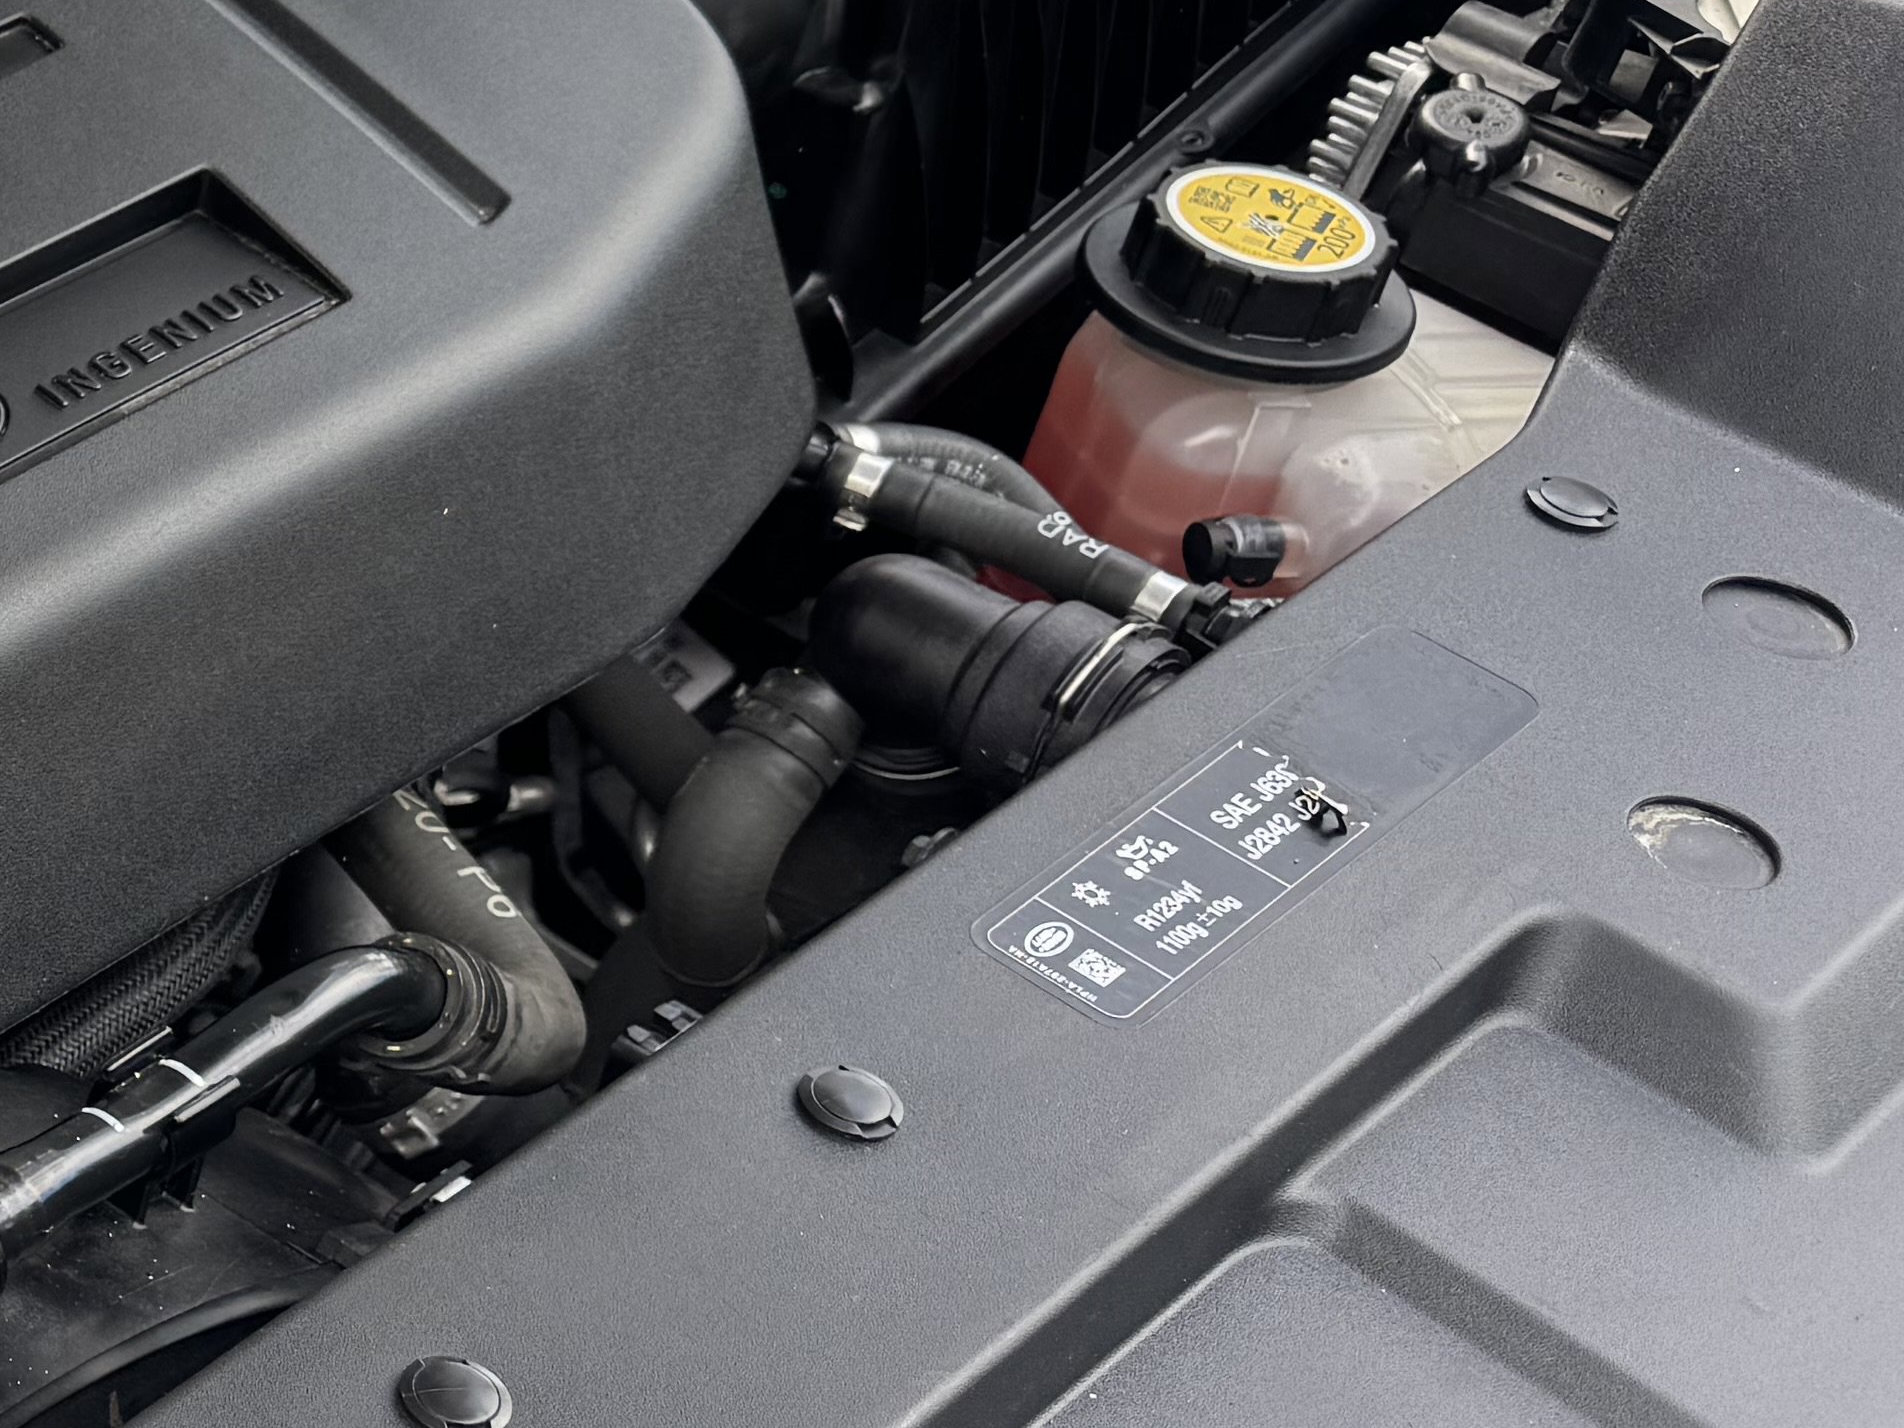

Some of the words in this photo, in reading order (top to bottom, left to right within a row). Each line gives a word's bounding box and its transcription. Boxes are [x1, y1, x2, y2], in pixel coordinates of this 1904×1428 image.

[1317, 226, 1356, 259] 200
[33, 275, 285, 411] INGENIUM
[1210, 792, 1262, 829] SAE
[1238, 813, 1301, 860] J2842
[1124, 840, 1179, 880] SP-A2
[1156, 921, 1210, 955] 1100g
